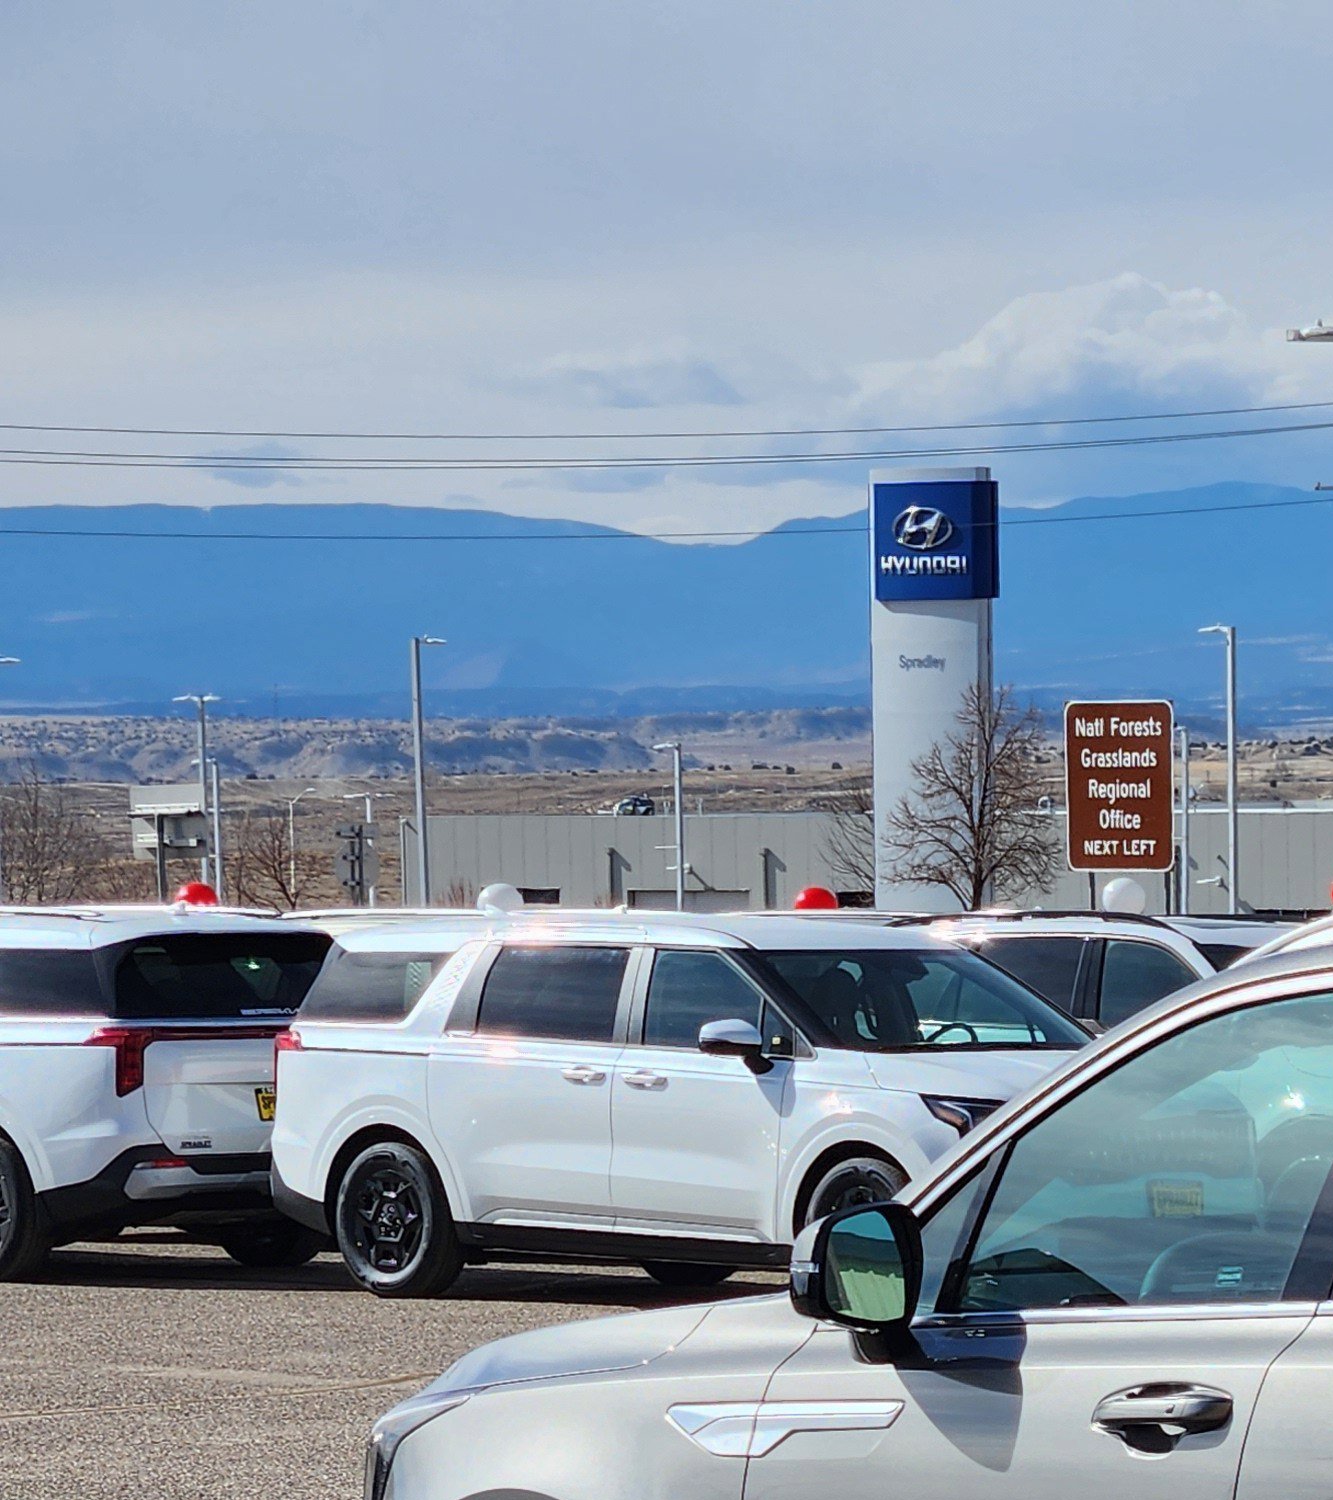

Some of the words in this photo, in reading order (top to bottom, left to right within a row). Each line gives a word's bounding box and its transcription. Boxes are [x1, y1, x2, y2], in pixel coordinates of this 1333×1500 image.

[880, 555, 967, 575] HYUNDAI
[899, 654, 947, 672] Spradley
[1110, 716, 1162, 737] Forests
[1081, 747, 1158, 768] Grasslands
[1088, 778, 1151, 805] Regional
[1099, 808, 1141, 829] Office
[1083, 840, 1119, 856] NEXT
[1123, 839, 1157, 856] LEFT
